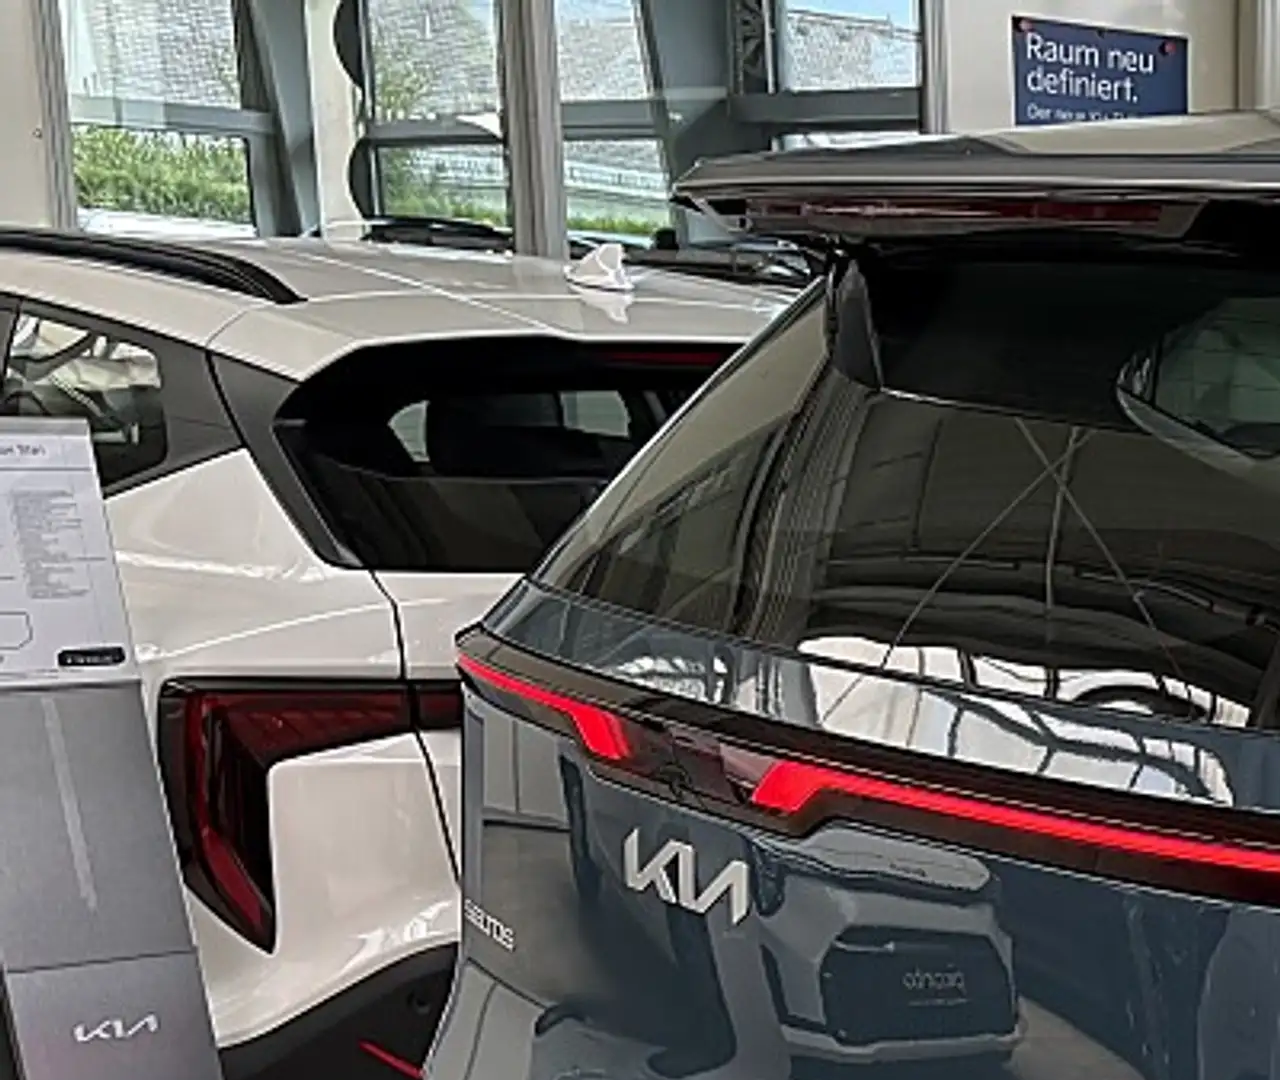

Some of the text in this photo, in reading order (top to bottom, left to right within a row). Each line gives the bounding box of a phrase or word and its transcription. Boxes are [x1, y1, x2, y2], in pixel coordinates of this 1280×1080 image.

[1026, 32, 1154, 74] Raum neu
[1026, 65, 1139, 104] definiert.
[623, 827, 750, 926] KIA
[73, 1013, 158, 1042] KIA
